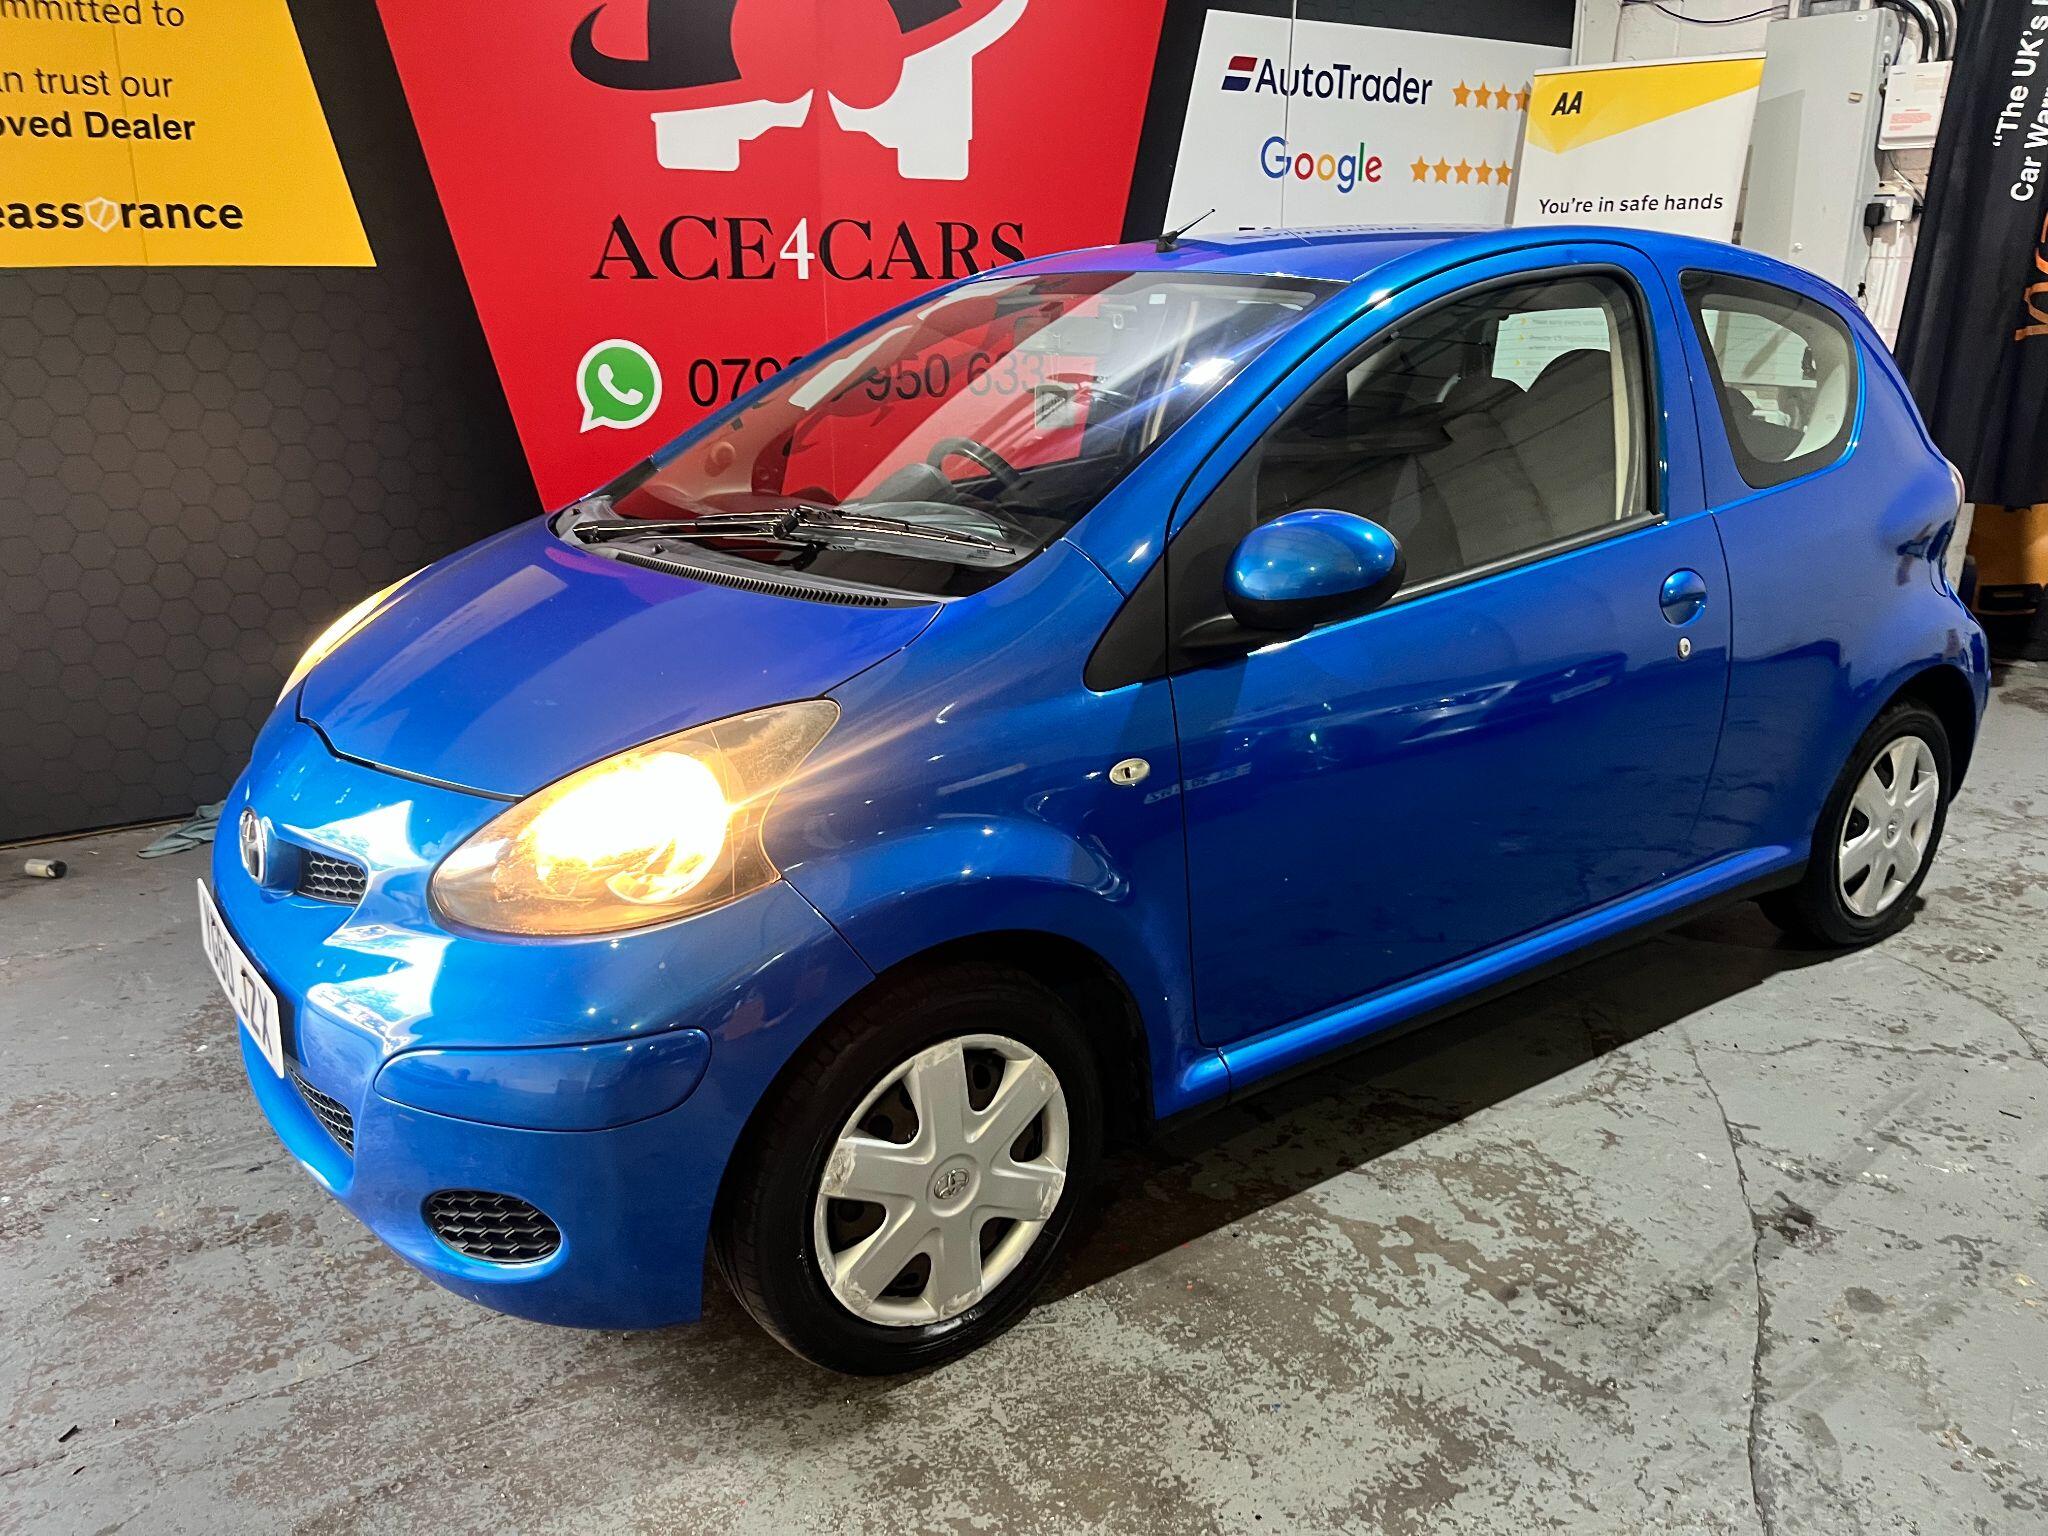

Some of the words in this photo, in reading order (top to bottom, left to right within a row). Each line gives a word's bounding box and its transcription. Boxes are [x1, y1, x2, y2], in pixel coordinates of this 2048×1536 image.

[152, 0, 185, 27] to
[34, 68, 111, 96] trust
[121, 76, 173, 98] our
[1255, 58, 1433, 105] AutoTrader
[1551, 91, 1583, 116] AA
[0, 110, 73, 139] ved
[84, 111, 196, 141] Dealer
[1260, 136, 1383, 194] Google
[2010, 156, 2042, 201] Car
[1539, 197, 1593, 215] You're
[1598, 196, 1614, 213] in
[1619, 194, 1659, 212] safe
[1664, 193, 1724, 211] hands
[590, 213, 1026, 281] ACE4CARS
